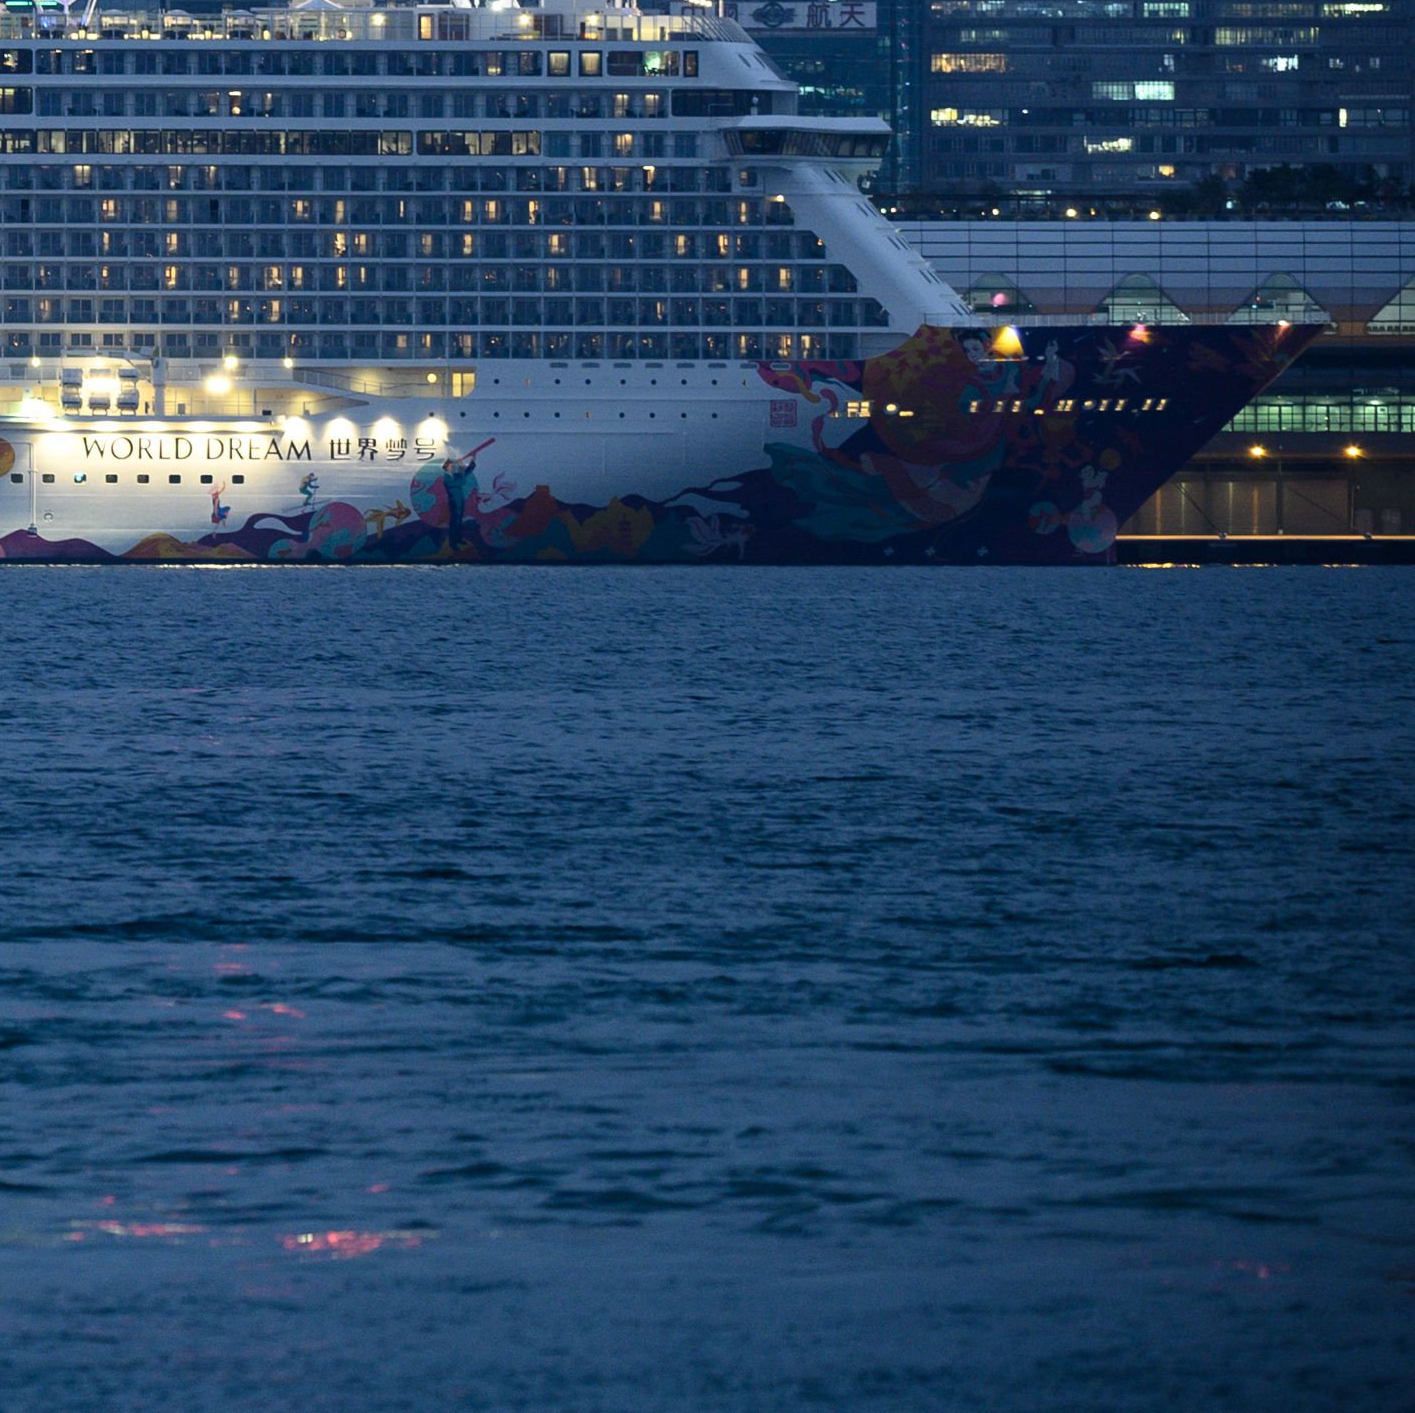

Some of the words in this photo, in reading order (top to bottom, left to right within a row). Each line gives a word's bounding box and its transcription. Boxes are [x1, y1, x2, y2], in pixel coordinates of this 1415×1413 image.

[83, 436, 193, 461] WORLD
[206, 437, 312, 461] DREAM
[329, 437, 438, 462] 世界梦号
